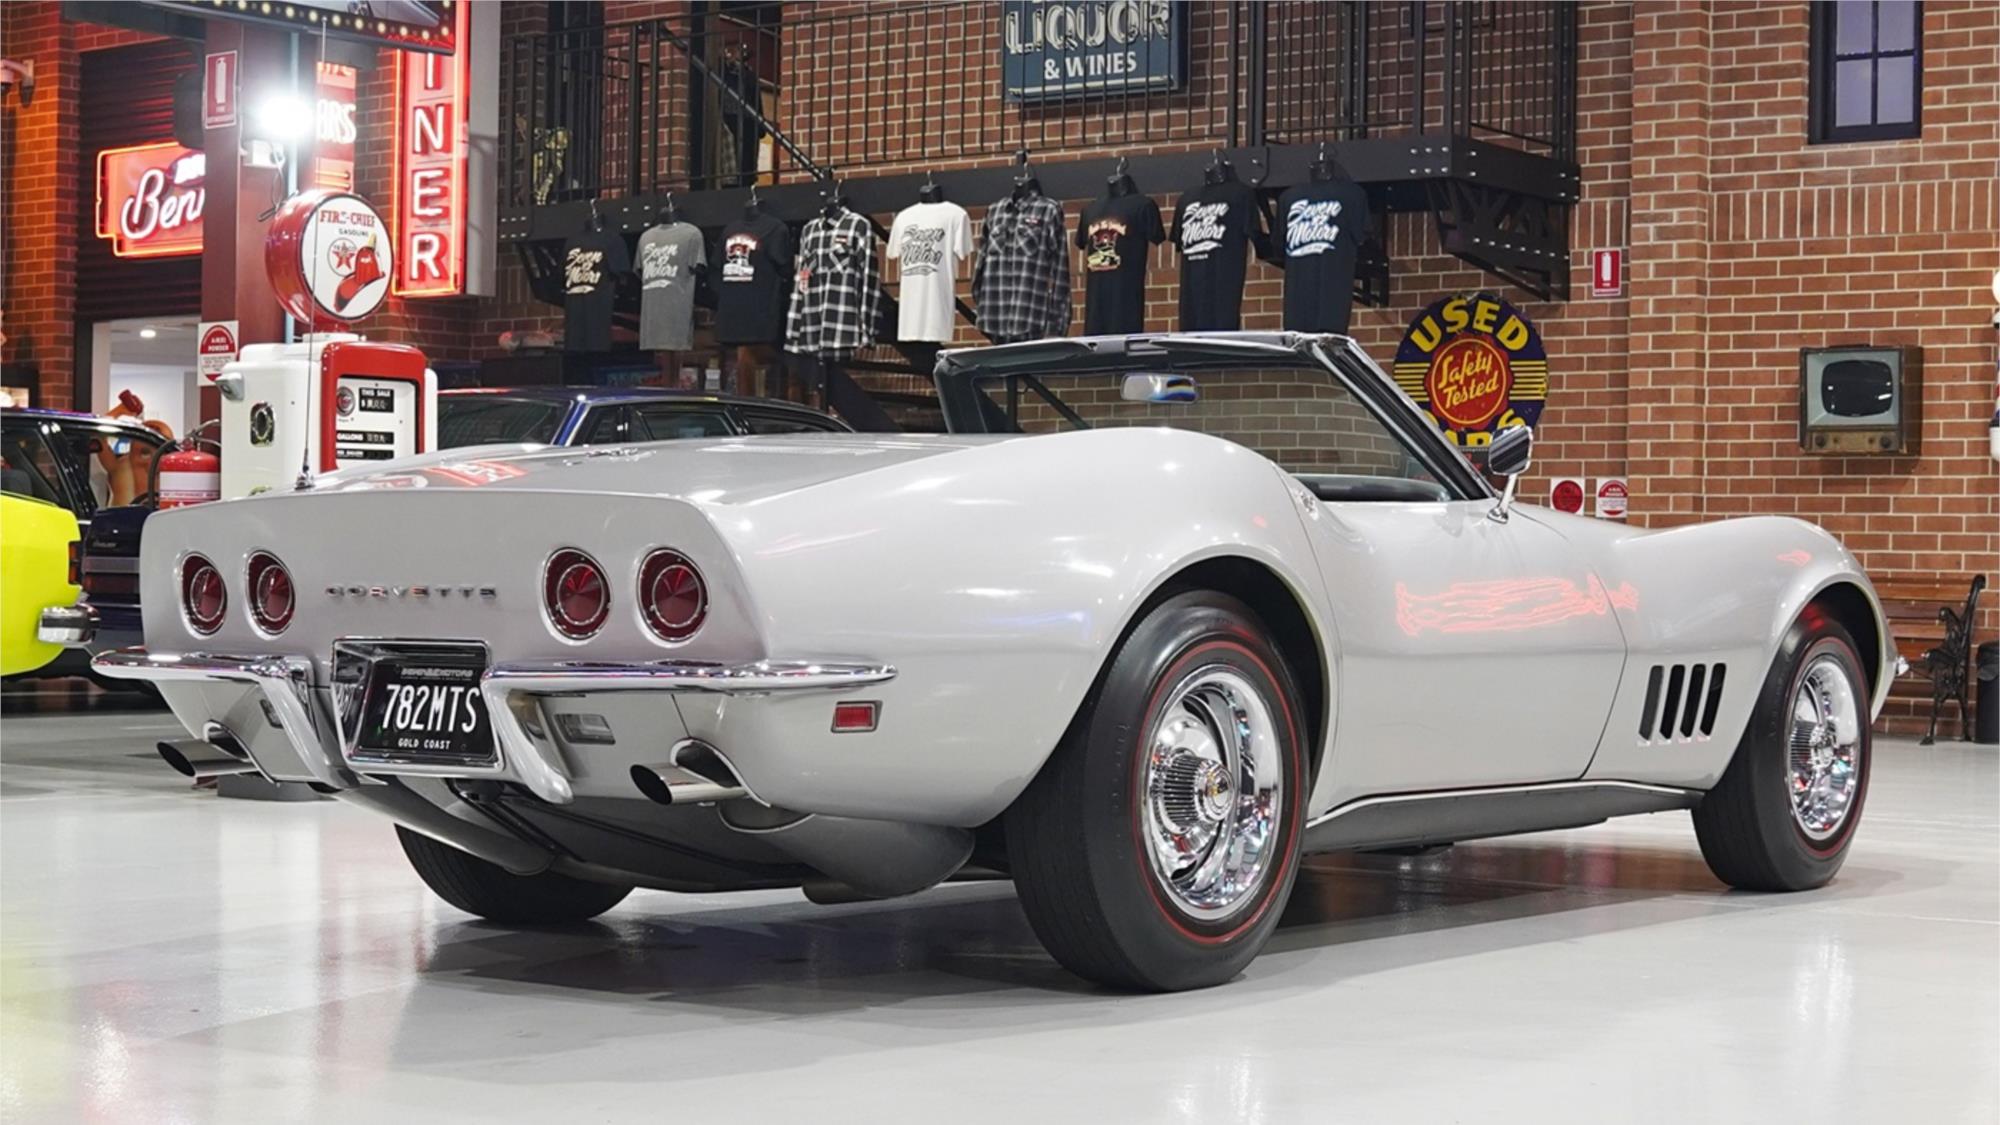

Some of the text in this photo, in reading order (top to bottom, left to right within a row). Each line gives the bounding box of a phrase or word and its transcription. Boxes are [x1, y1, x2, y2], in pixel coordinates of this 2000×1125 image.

[1005, 0, 1171, 54] LIQUOR
[1044, 51, 1137, 80] & WINES
[410, 53, 452, 282] INER
[1182, 201, 1229, 228] Seven
[1287, 199, 1342, 228] Seven
[1181, 222, 1226, 247] Motors
[1286, 221, 1339, 250] Motors
[1410, 299, 1529, 353] USED
[1438, 350, 1493, 389] Safety
[1443, 371, 1499, 409] Tested
[325, 584, 497, 600] CORVETTE
[382, 684, 481, 733] 782MTS
[398, 737, 451, 750] GOLD COAST
